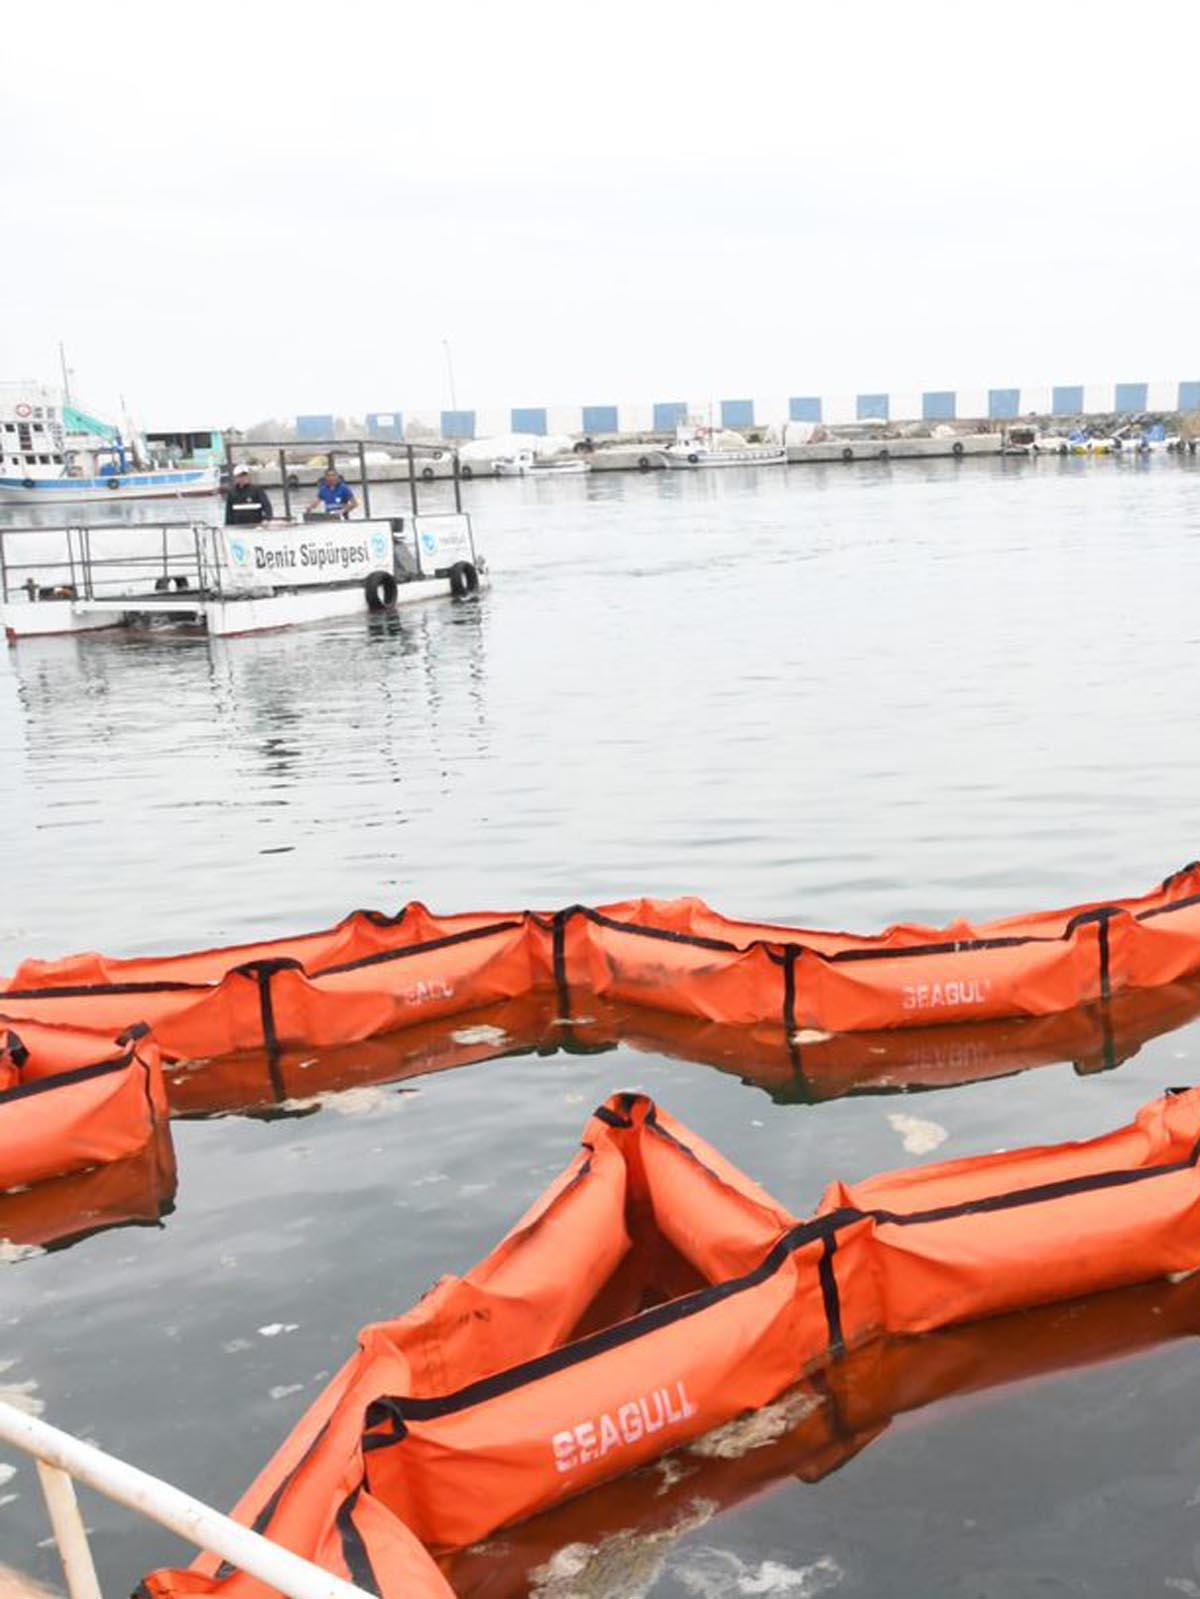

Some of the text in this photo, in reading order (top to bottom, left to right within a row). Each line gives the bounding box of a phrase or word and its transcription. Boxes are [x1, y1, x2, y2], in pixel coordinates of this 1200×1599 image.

[254, 540, 370, 571] Deniz Süpürgesi
[552, 1380, 699, 1474] SEAGULL
